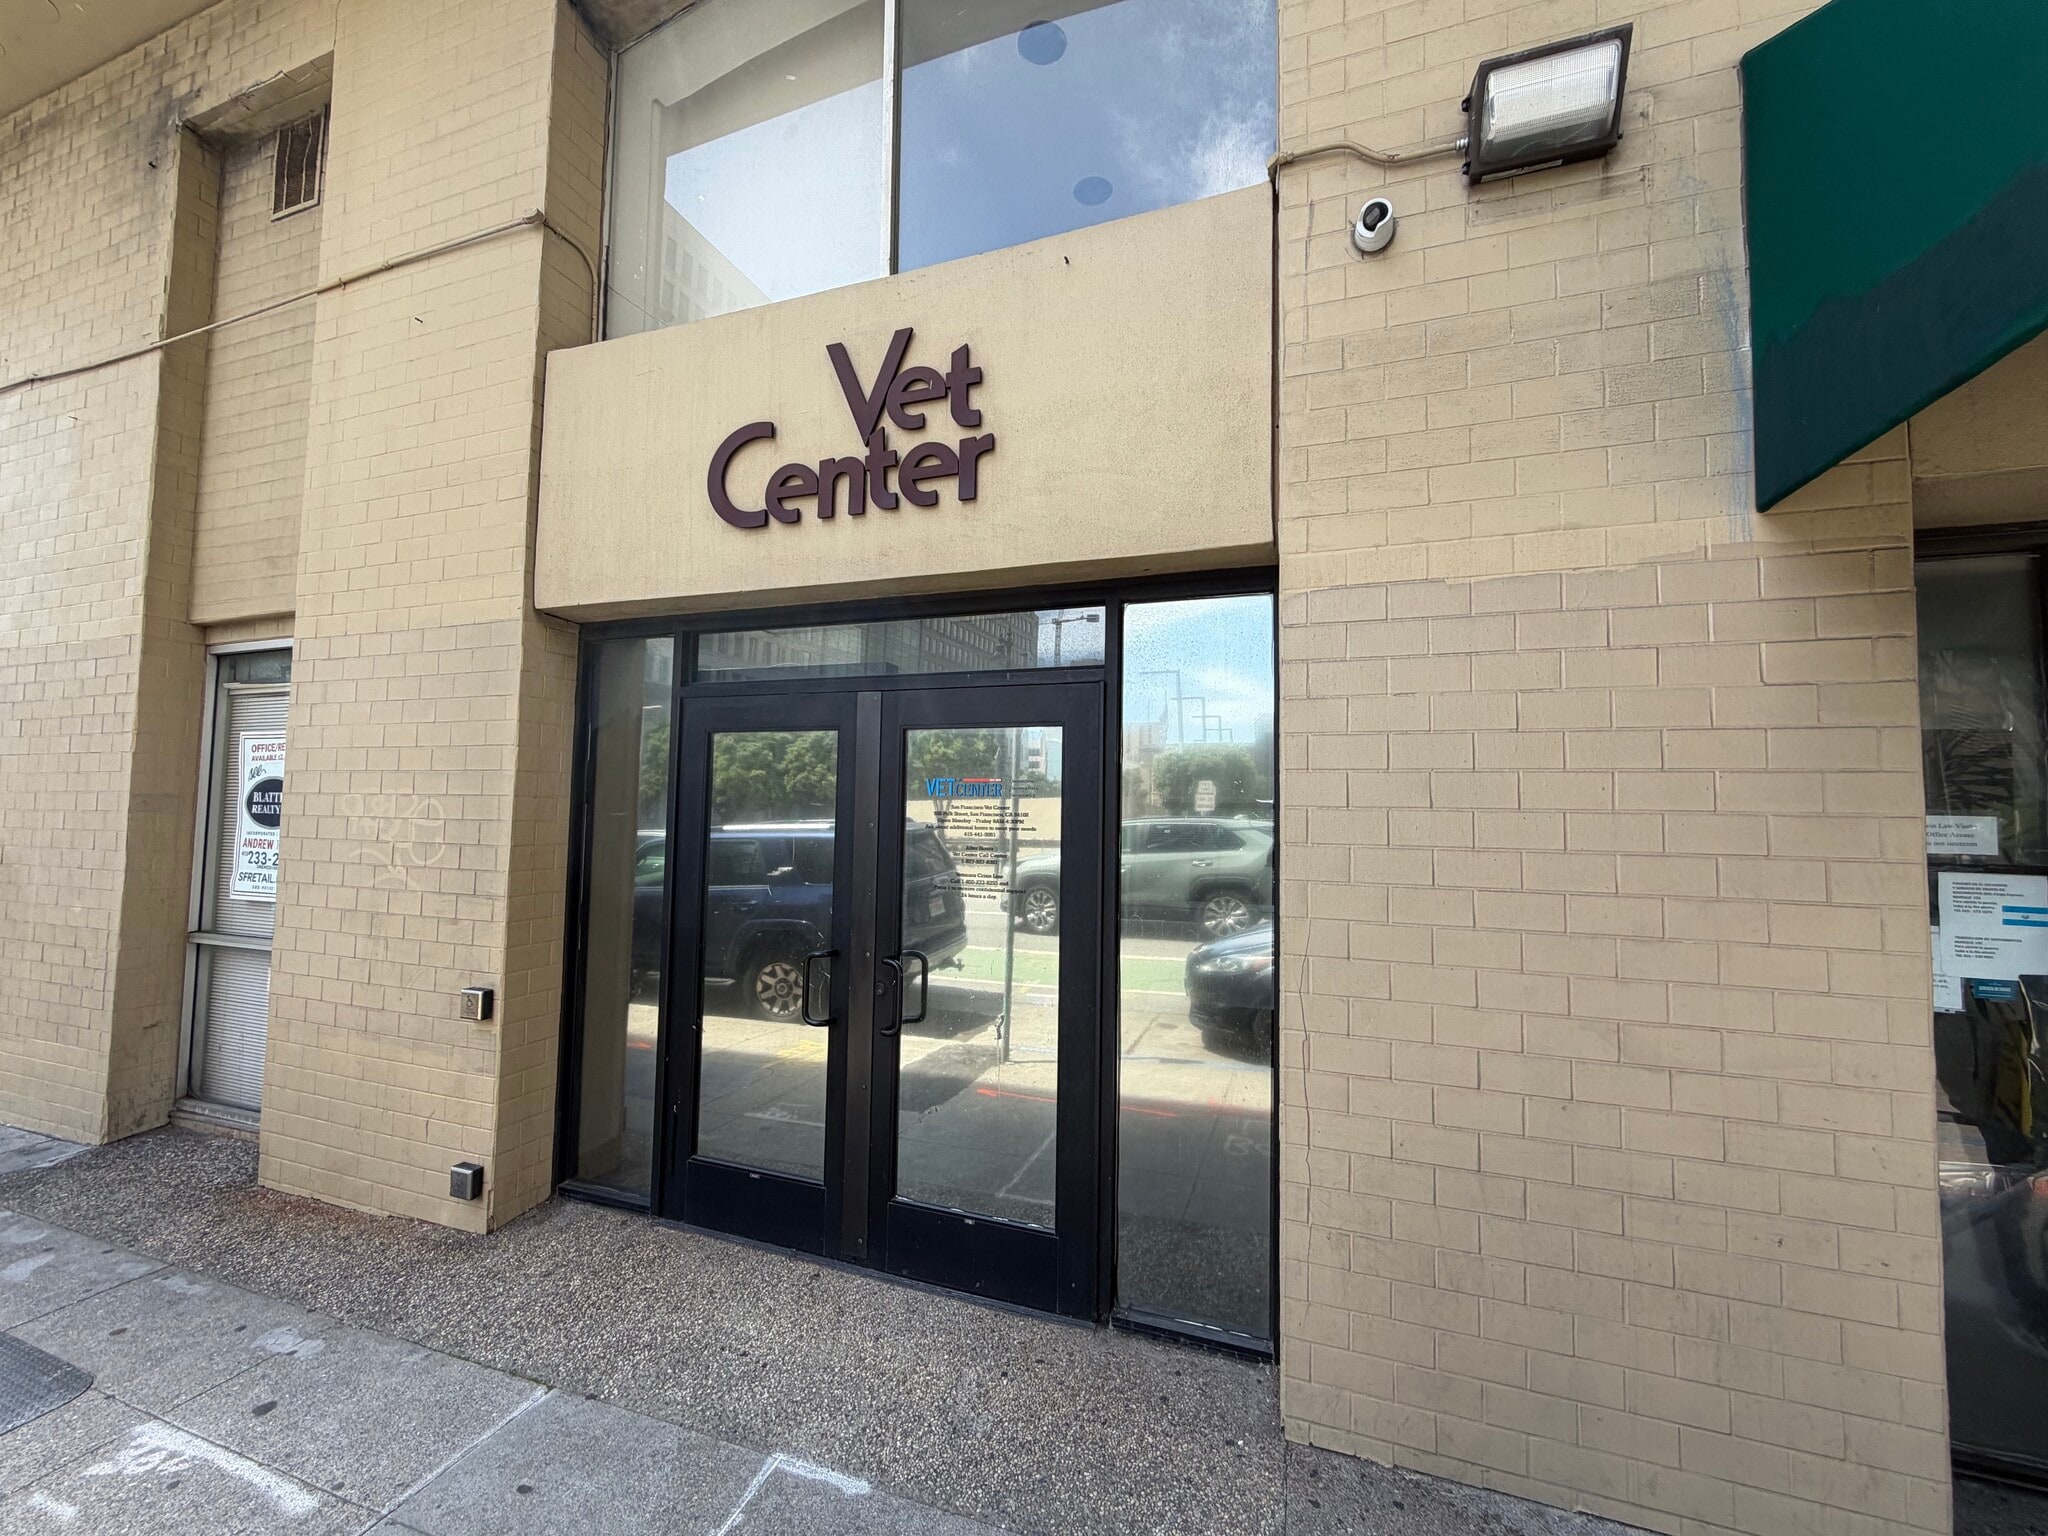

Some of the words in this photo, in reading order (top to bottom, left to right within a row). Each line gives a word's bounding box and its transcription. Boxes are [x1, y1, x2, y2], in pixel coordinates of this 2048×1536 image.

[826, 327, 982, 448] Vet
[707, 421, 995, 529] Center
[926, 777, 957, 798] VET
[955, 783, 1003, 797] CENTER
[251, 804, 281, 815] REALTY
[951, 817, 971, 825] Monday
[242, 837, 275, 850] ANDREW
